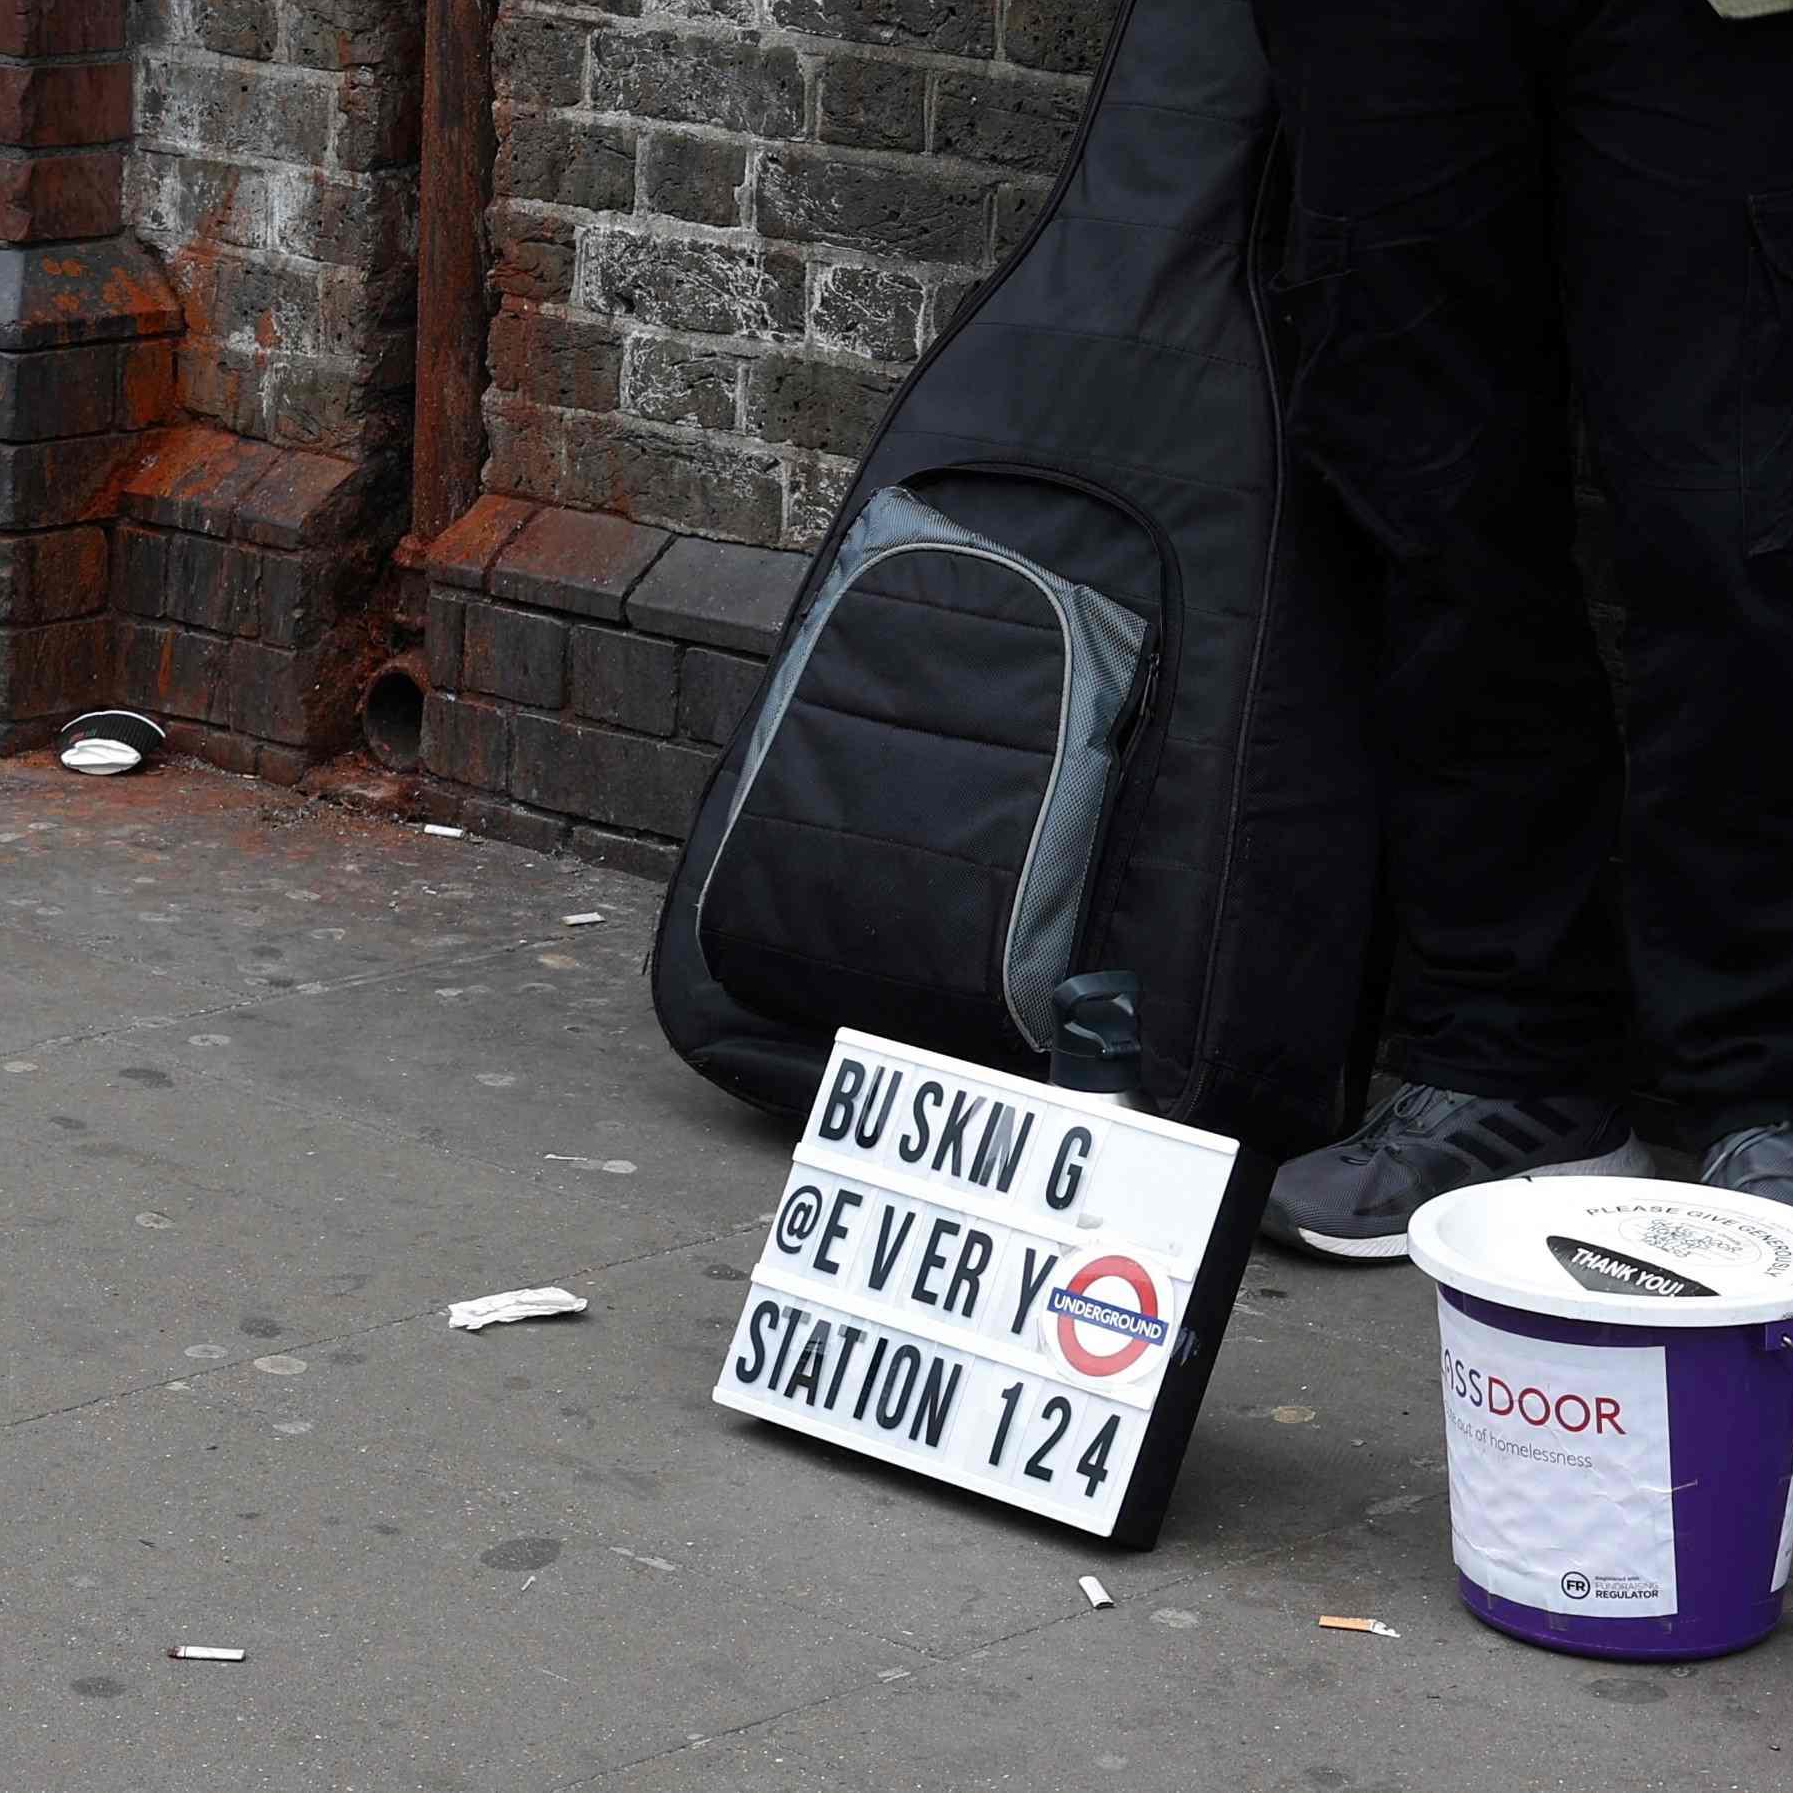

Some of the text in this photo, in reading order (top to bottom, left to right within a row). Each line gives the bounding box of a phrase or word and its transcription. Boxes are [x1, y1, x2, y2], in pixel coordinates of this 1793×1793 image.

[1586, 1204, 1792, 1278] PLEASE GIVE GENEROUSLY
[1571, 1248, 1685, 1298] THANK YOU!
[1053, 1293, 1163, 1339] UNDERGROUND
[735, 1300, 1122, 1499] STATION 124
[1442, 1348, 1628, 1436] ASSDOOR
[1475, 1428, 1488, 1443] of
[1490, 1434, 1593, 1469] homelessness
[1566, 1579, 1586, 1592] FR
[1595, 1590, 1659, 1599] REGULATOR
